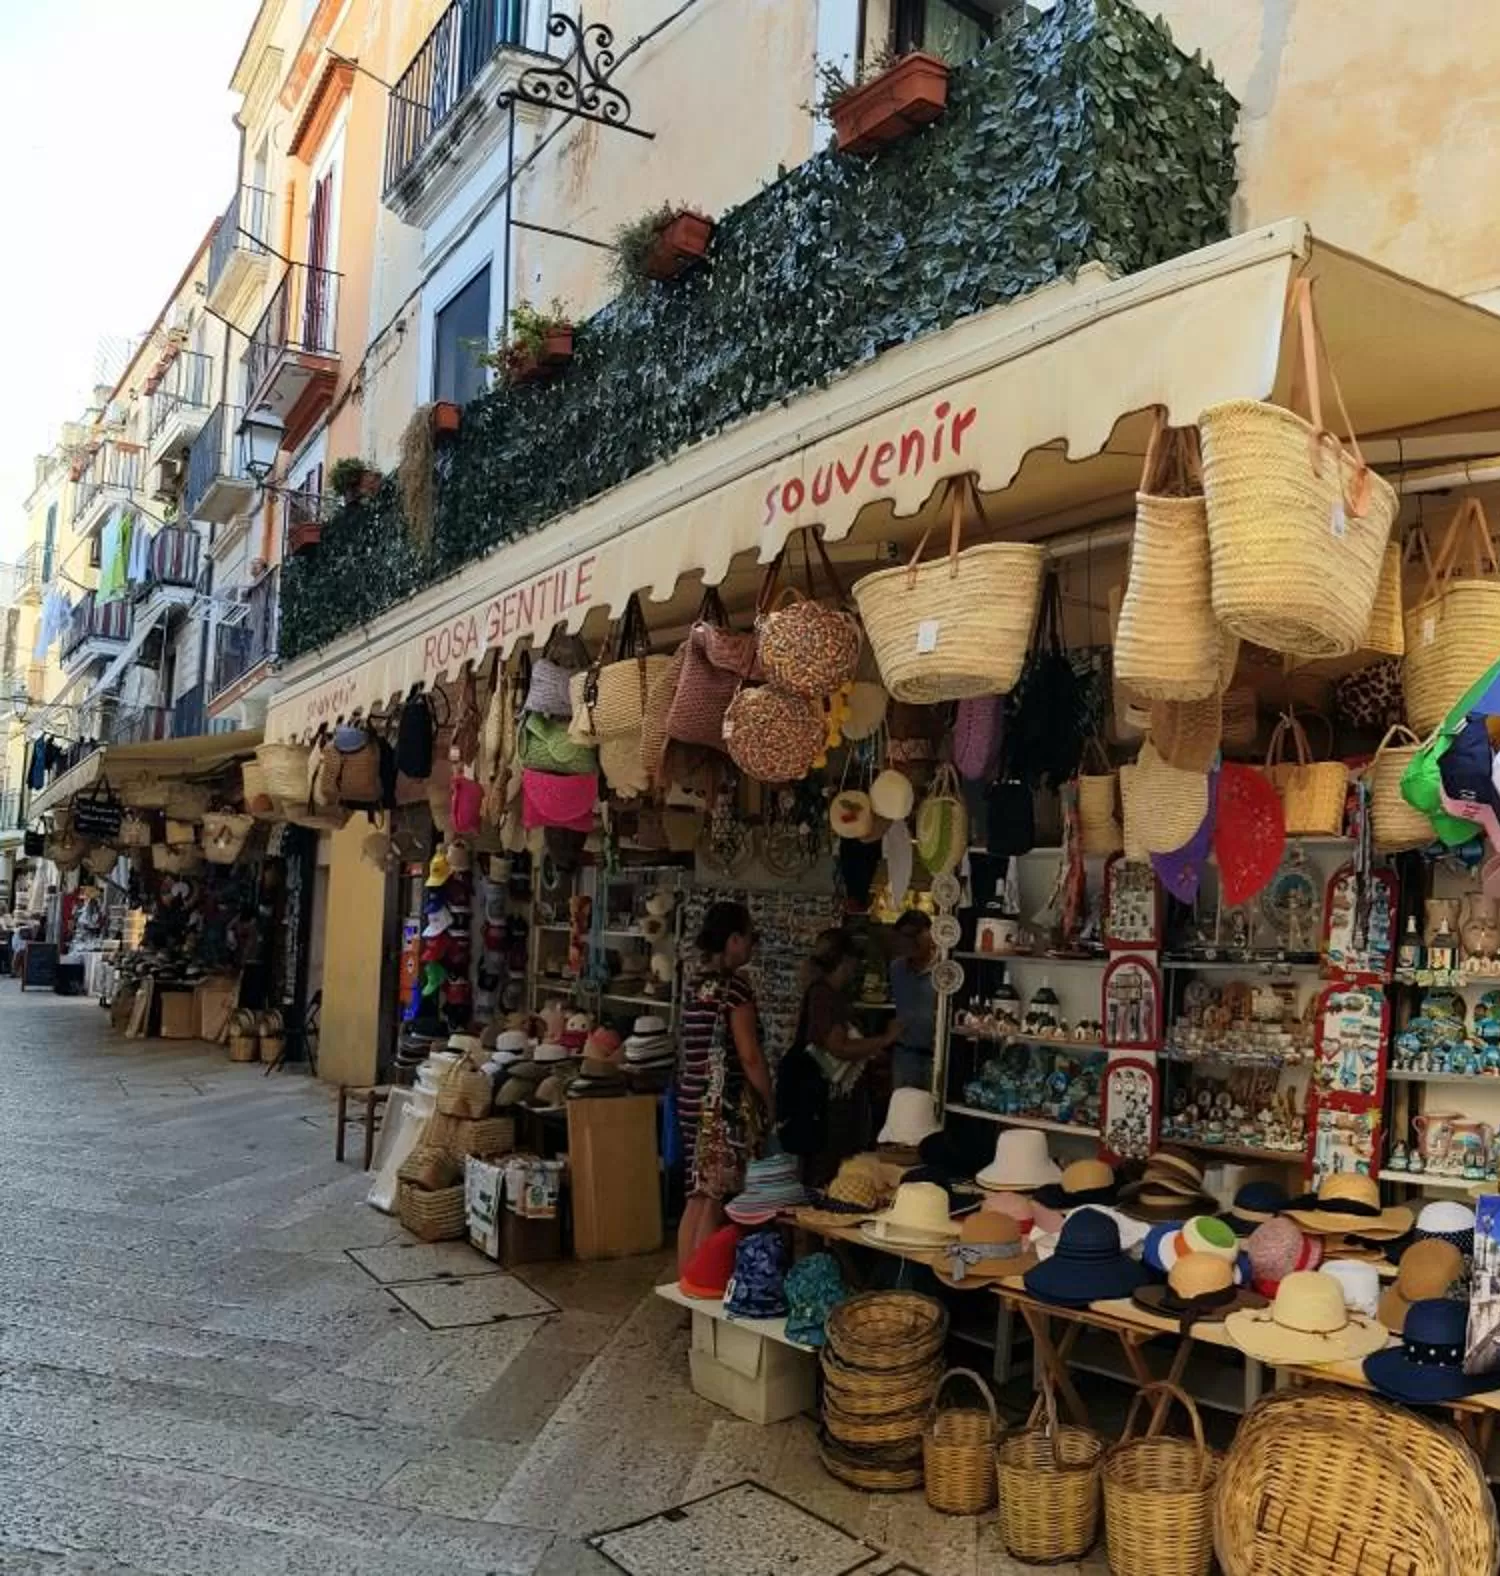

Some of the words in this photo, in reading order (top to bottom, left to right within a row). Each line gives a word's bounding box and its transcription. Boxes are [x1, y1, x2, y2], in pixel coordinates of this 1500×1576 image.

[766, 401, 977, 526] souvenir
[424, 620, 479, 673] ROSA
[486, 555, 597, 642] GENTILE
